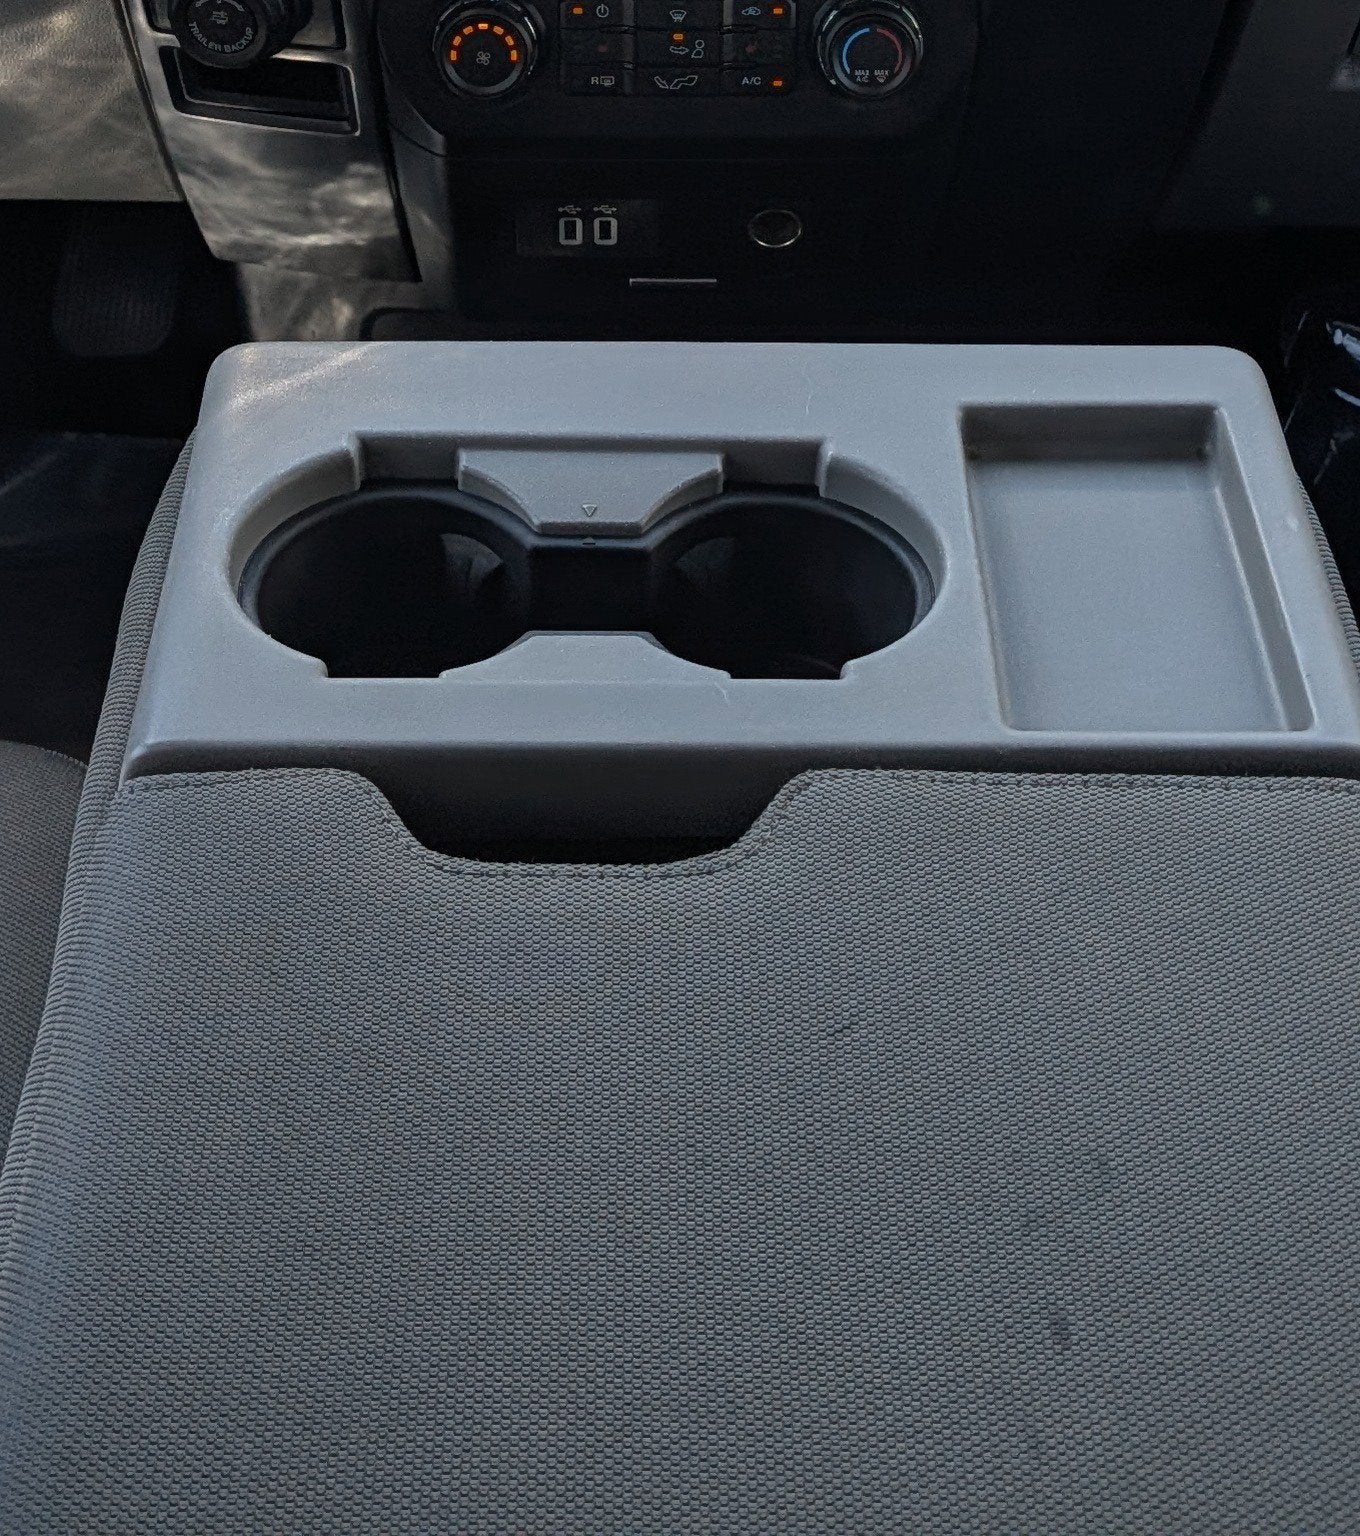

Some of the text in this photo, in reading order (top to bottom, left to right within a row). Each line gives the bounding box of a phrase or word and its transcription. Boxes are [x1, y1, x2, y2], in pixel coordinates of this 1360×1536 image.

[223, 27, 254, 54] BACKUP
[590, 76, 600, 85] R
[741, 76, 762, 86] A/C
